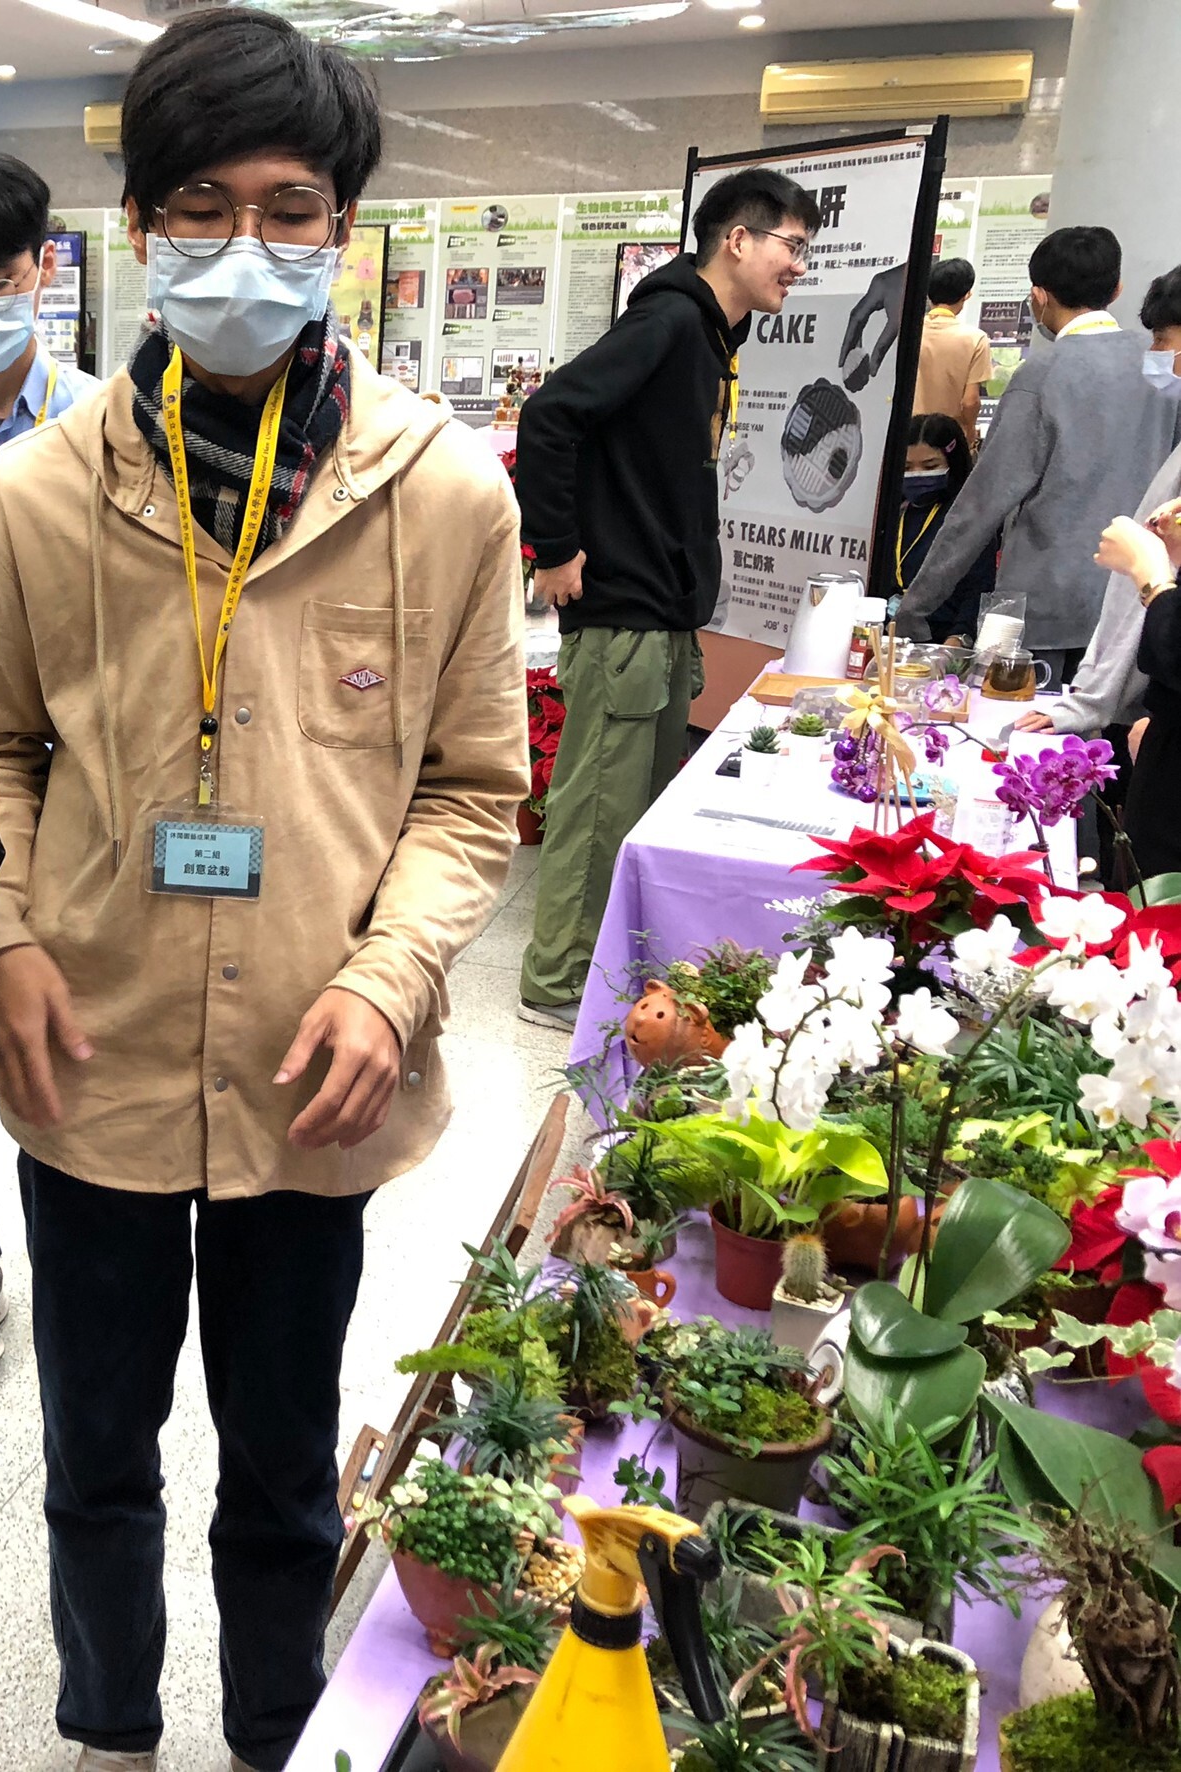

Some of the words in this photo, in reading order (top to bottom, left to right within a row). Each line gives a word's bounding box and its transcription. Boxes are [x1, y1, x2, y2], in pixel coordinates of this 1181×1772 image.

[805, 185, 847, 228] 肝
[756, 314, 817, 344] CAKE
[740, 521, 787, 548] TEARS
[789, 529, 834, 556] MILK
[840, 537, 867, 562] TEA
[733, 550, 775, 573] 薏仁奶茶
[194, 849, 221, 860] 第二組
[183, 862, 231, 877] 創意盆栽
